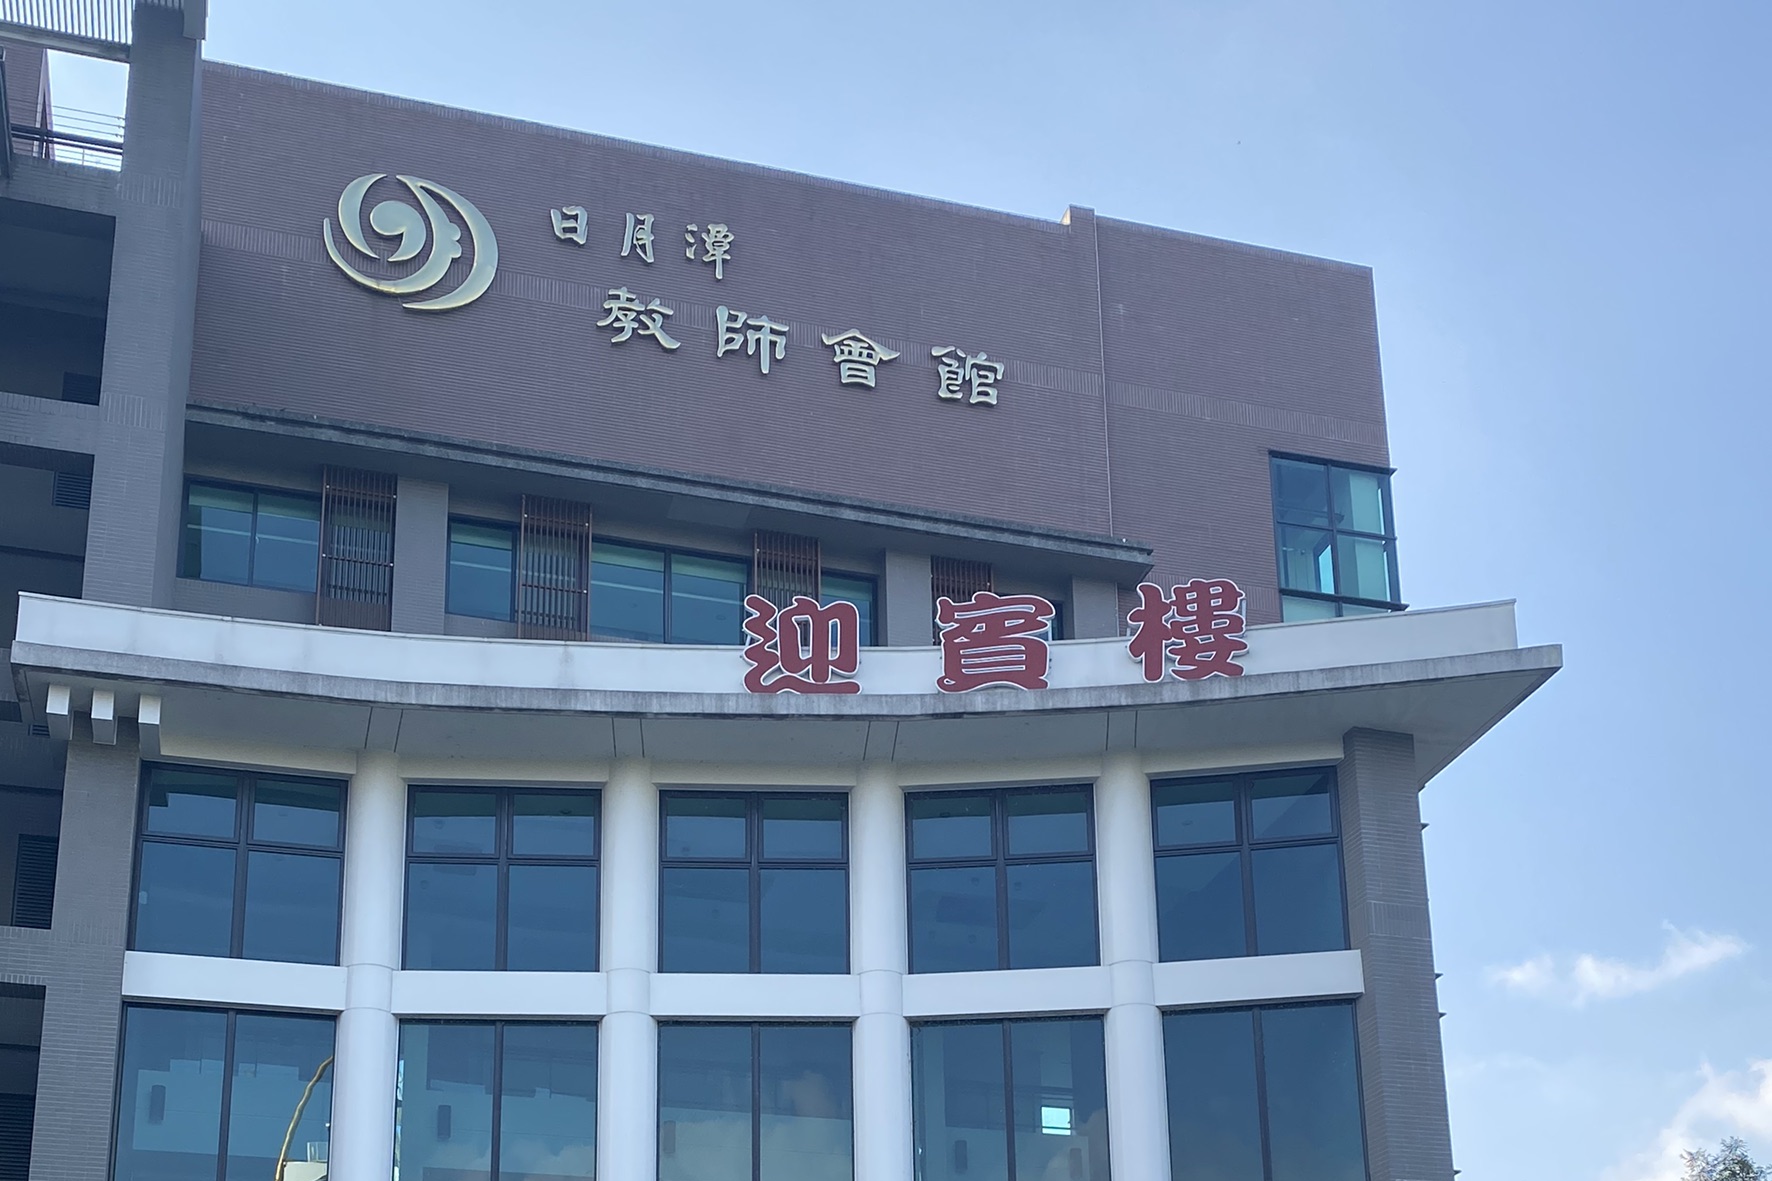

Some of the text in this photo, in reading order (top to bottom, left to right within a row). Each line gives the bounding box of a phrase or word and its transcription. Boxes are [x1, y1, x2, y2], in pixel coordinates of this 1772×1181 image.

[549, 205, 735, 279] 日月潭
[596, 286, 1005, 407] 教師會館
[742, 578, 1250, 695] 迎賓樓
